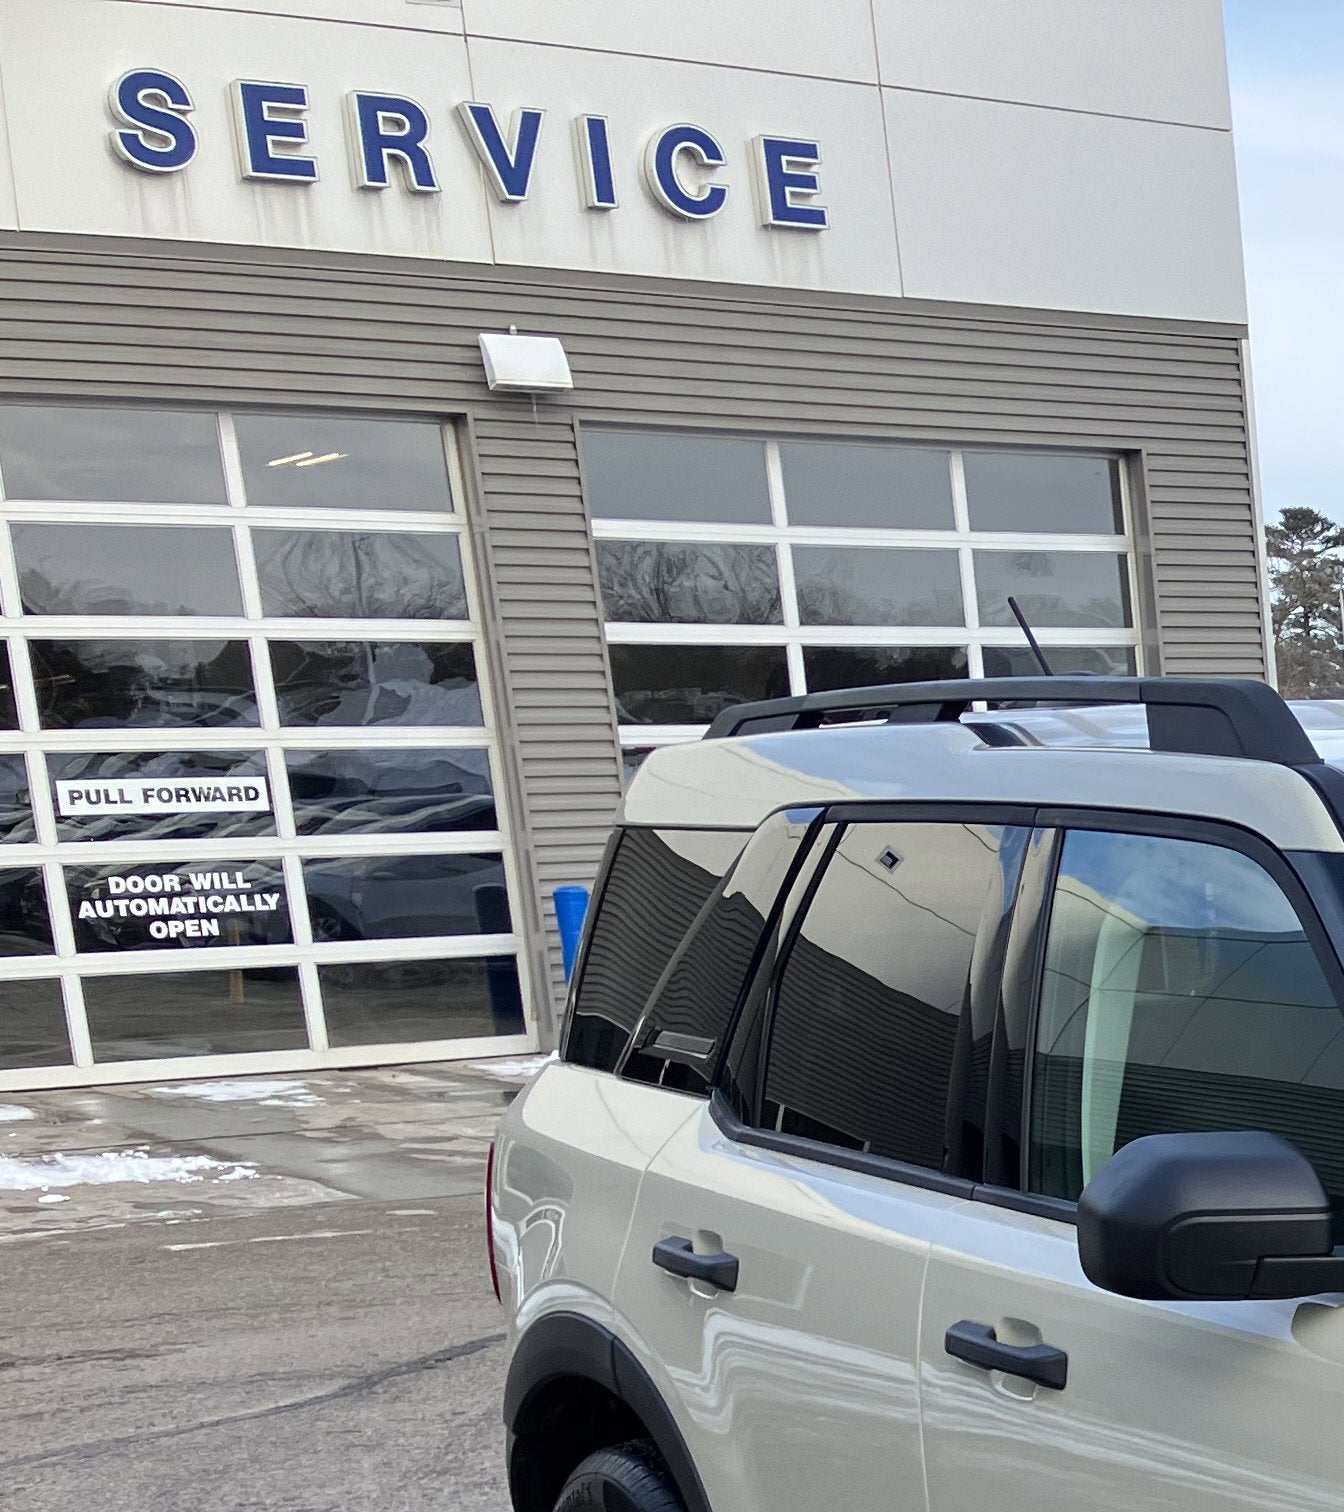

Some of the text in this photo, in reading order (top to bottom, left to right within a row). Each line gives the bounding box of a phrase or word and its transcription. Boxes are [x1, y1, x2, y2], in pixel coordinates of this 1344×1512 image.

[109, 67, 831, 231] SERVICE
[68, 786, 260, 806] PULL FORWARD
[108, 871, 251, 895] DOOR WILL
[78, 893, 280, 919] AUTOMATICALLY
[149, 919, 220, 939] OPEN
